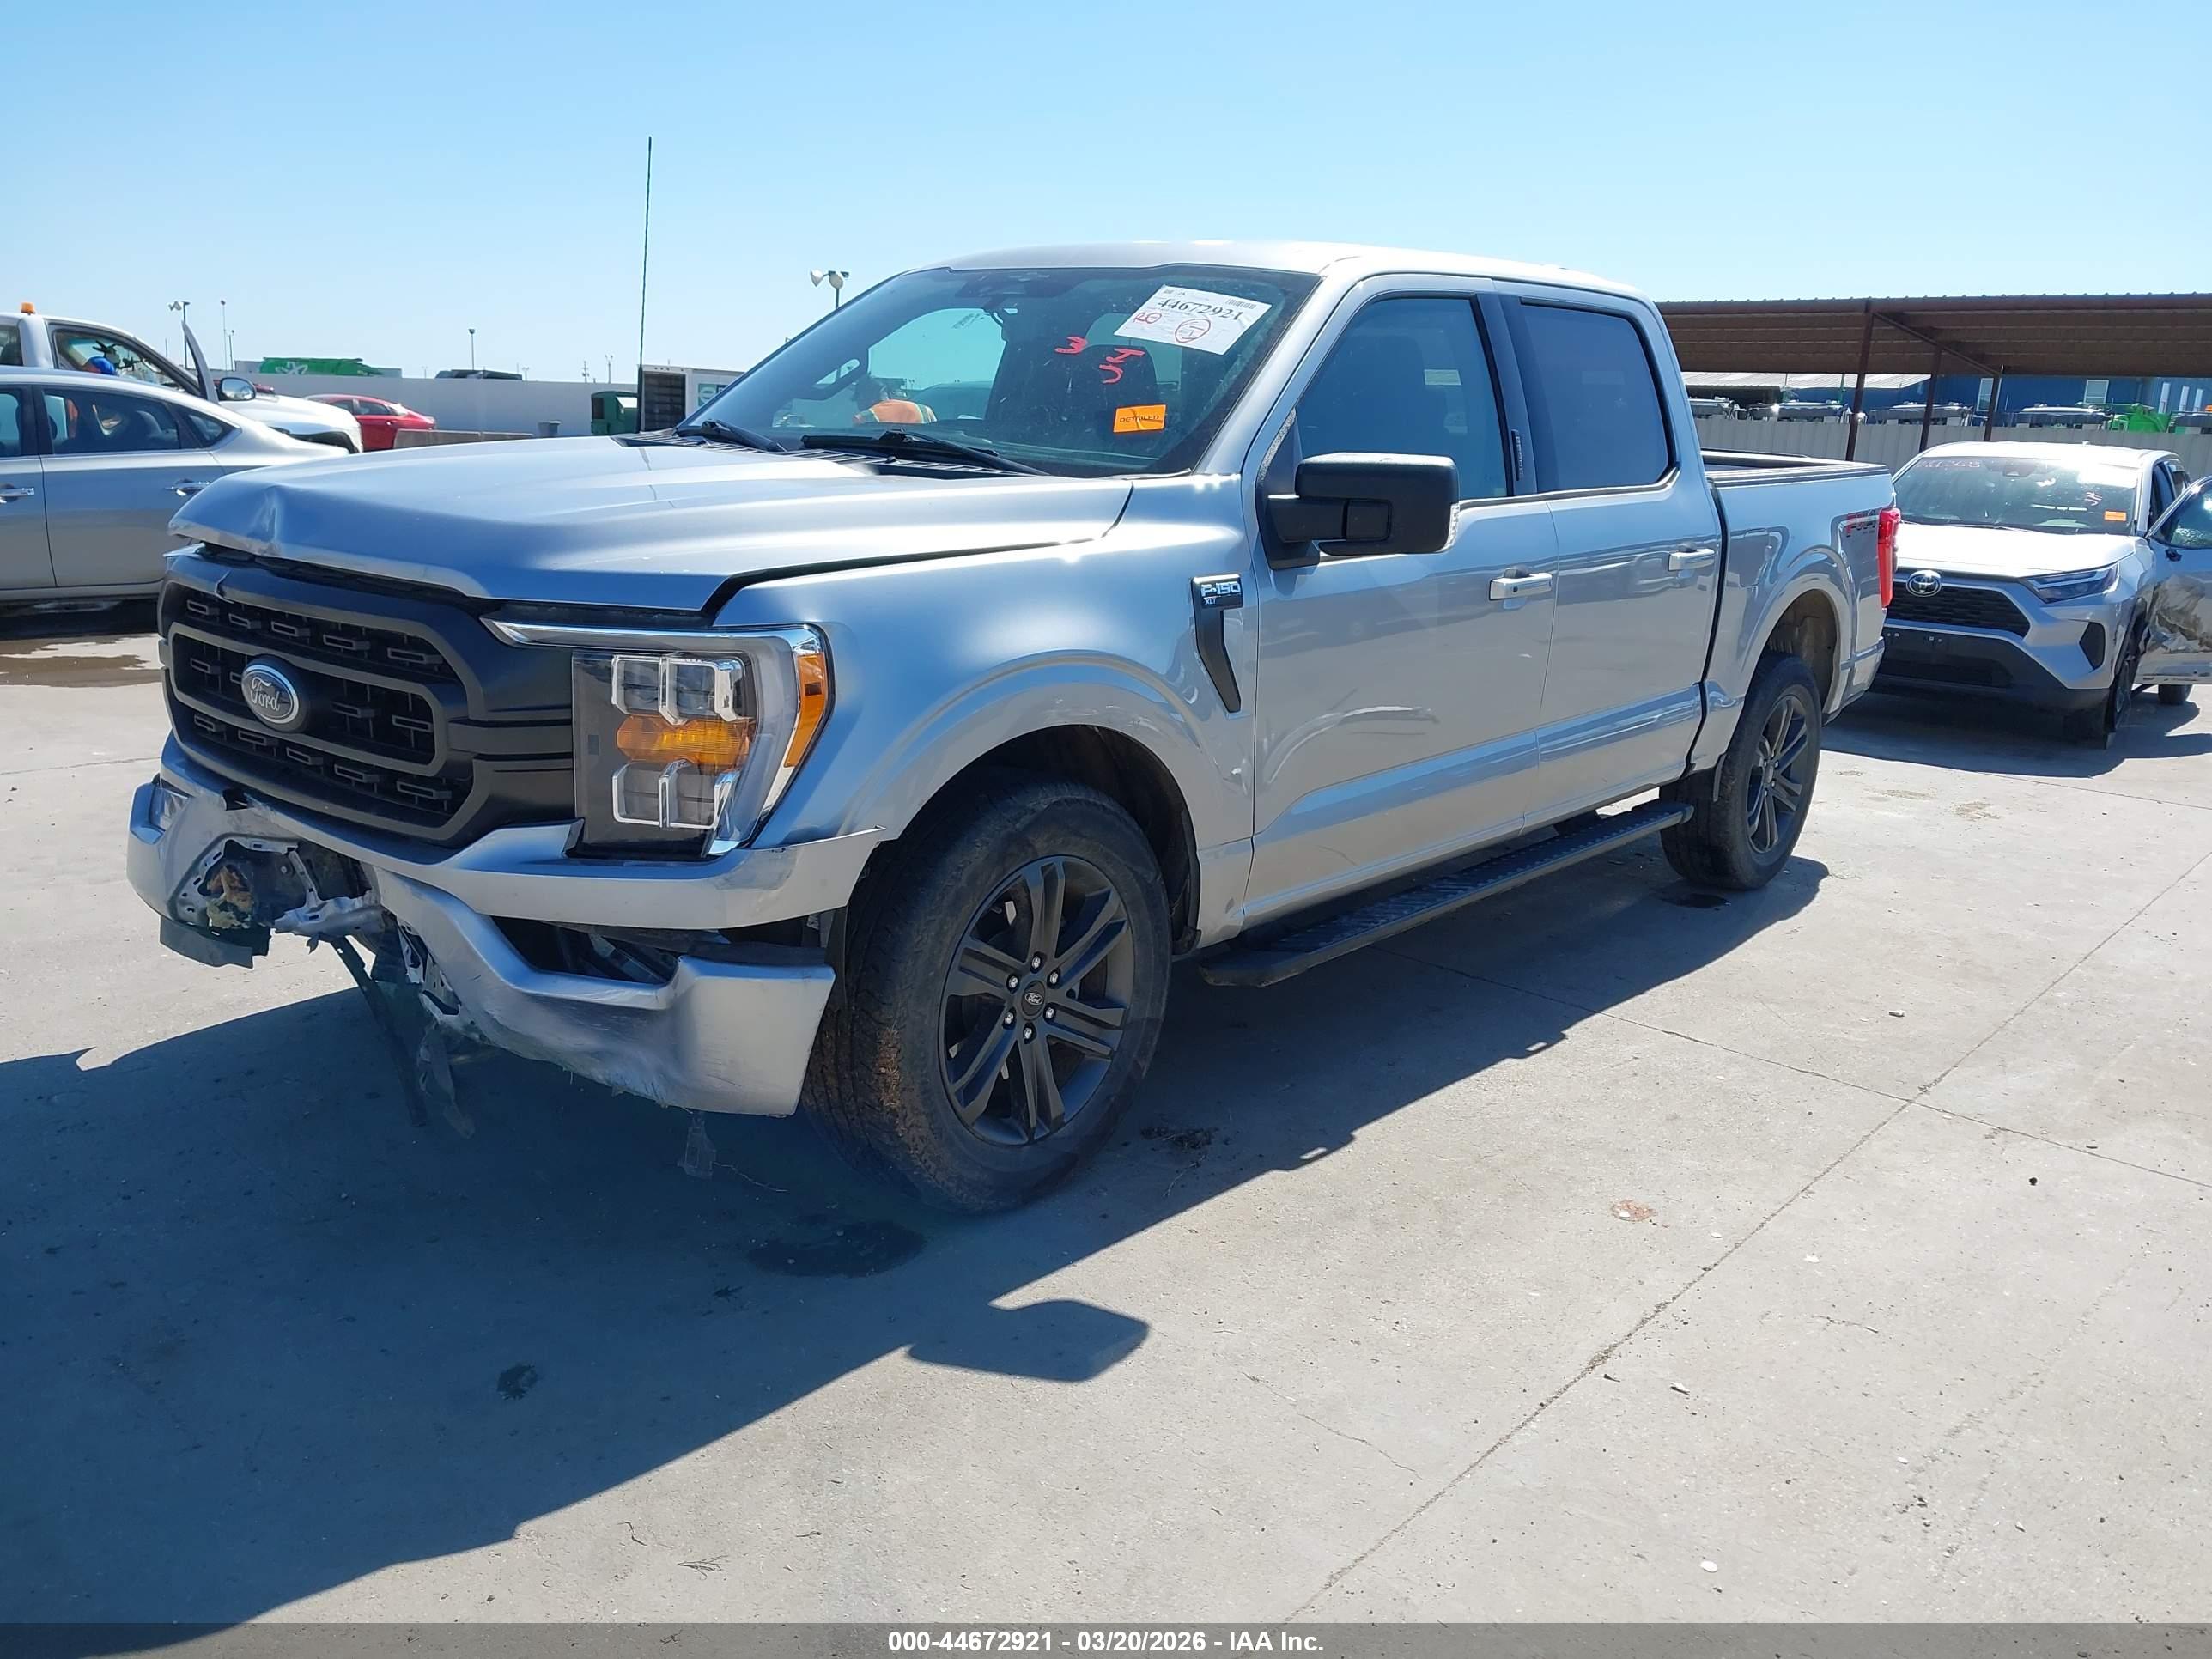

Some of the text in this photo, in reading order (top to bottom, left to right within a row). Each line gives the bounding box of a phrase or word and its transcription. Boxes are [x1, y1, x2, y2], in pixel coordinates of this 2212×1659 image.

[1158, 298, 1244, 321] 44672921
[1200, 581, 1241, 597] F-150
[250, 677, 280, 712] Ford
